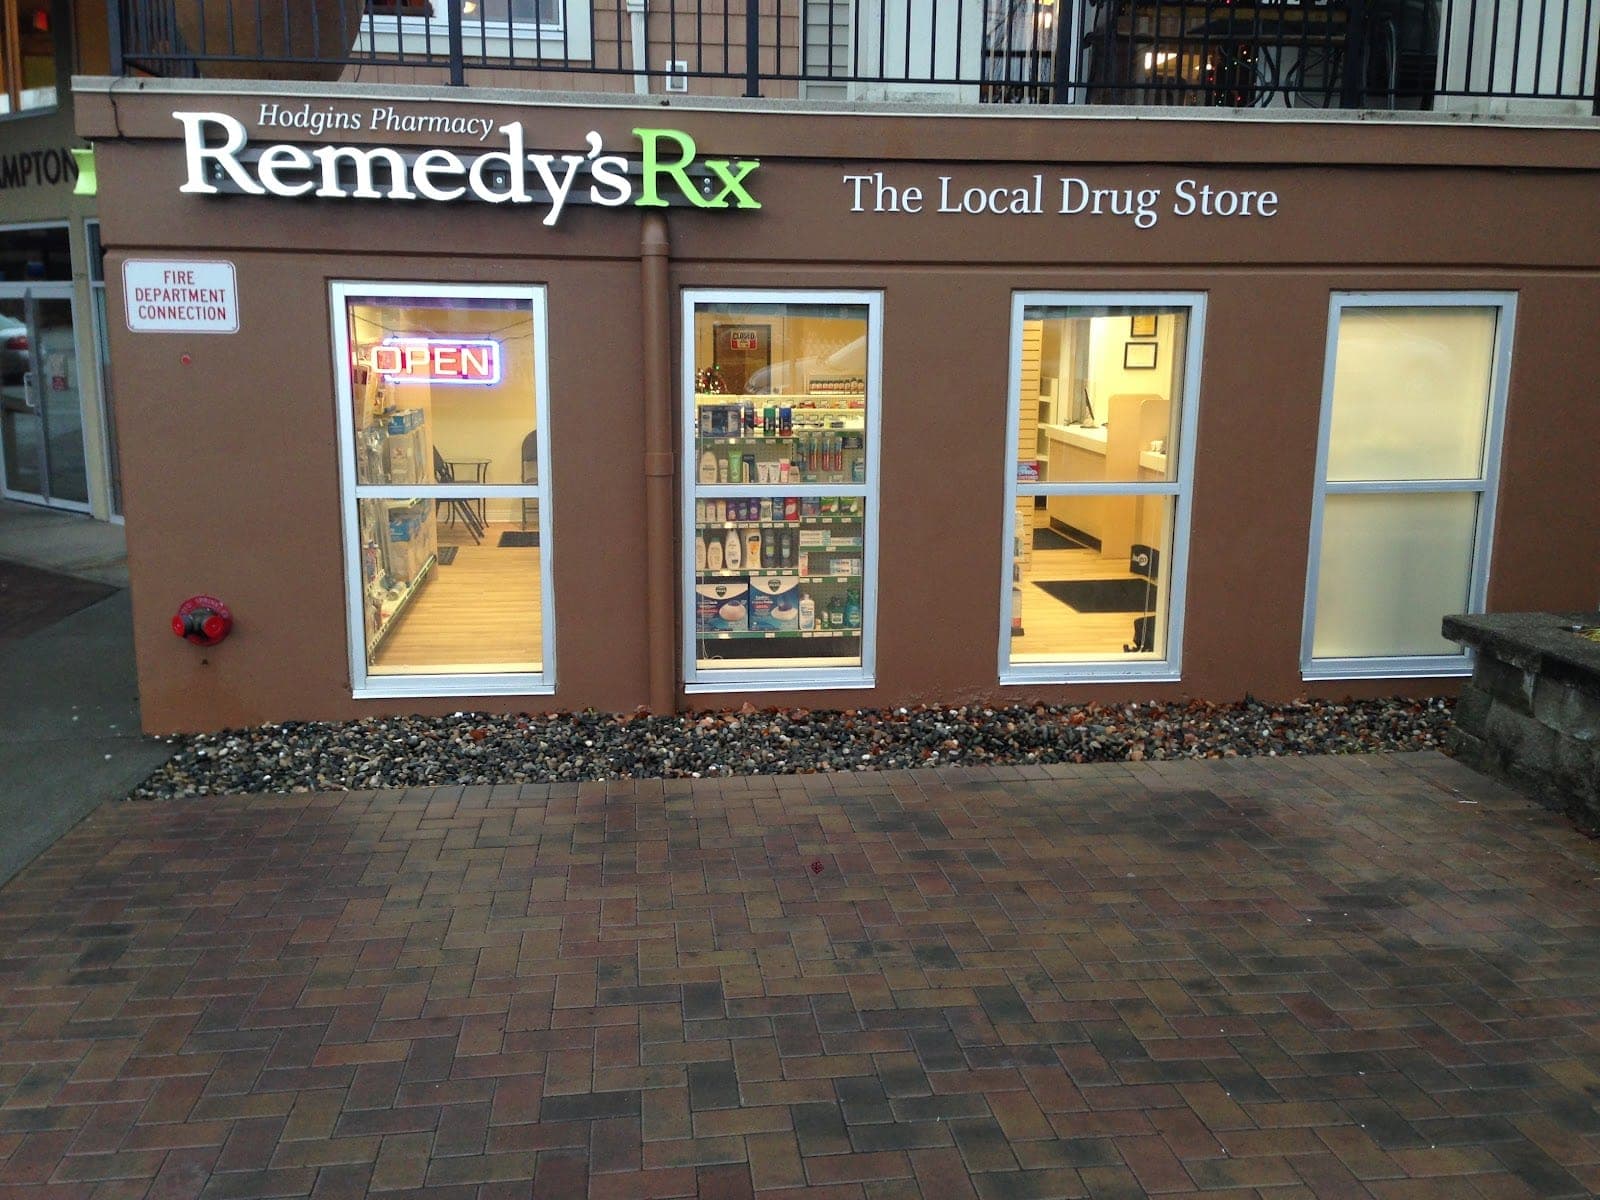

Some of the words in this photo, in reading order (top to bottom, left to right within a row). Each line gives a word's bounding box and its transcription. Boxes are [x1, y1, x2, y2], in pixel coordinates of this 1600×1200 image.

[258, 103, 362, 135] Hodgins
[369, 108, 494, 141] Pharmacy
[0, 147, 79, 190] MPTON
[843, 172, 923, 213] The
[937, 174, 1043, 215] Local
[1058, 177, 1161, 229] Drug
[1174, 179, 1279, 218] Store
[163, 269, 195, 285] FIRE
[134, 287, 226, 304] DEPARTMENT
[137, 305, 227, 321] CONNECTION
[370, 346, 489, 375] OPEN
